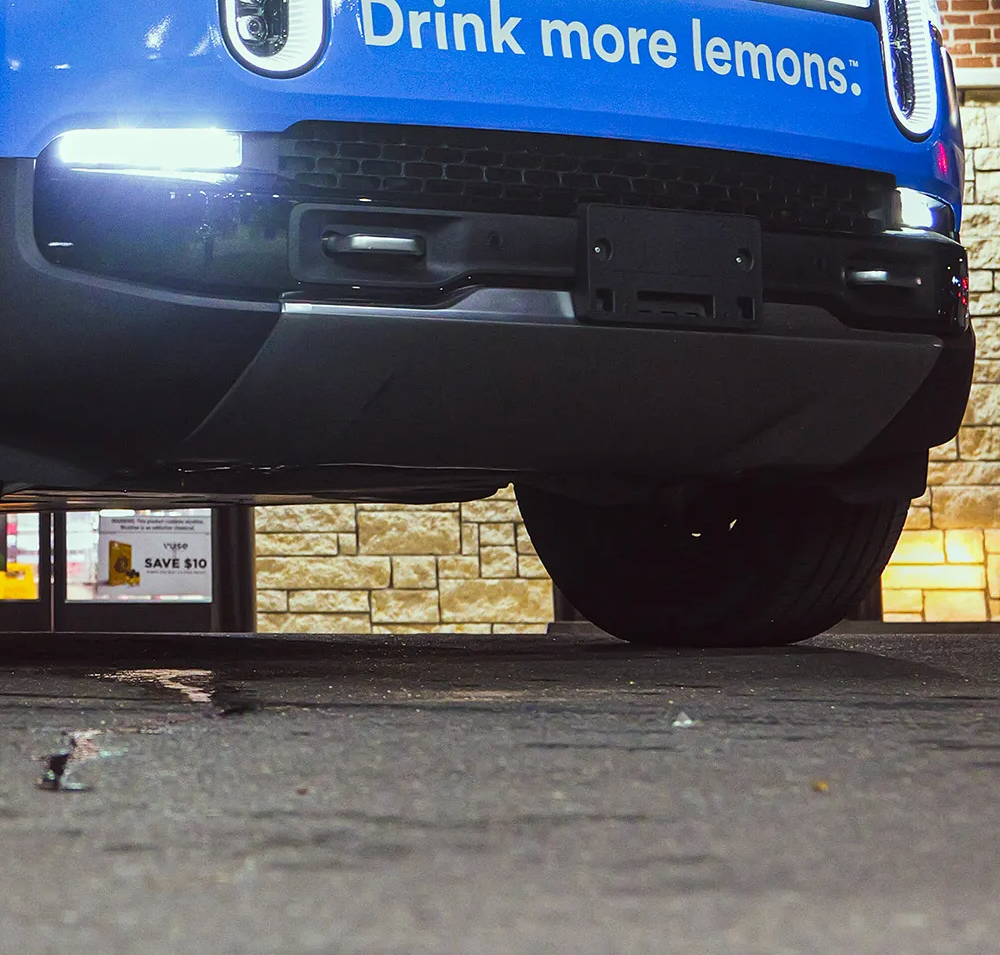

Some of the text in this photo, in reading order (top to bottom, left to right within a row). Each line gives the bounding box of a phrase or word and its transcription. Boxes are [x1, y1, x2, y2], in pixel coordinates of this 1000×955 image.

[541, 19, 677, 68] more
[144, 557, 207, 569] SAVE $10
